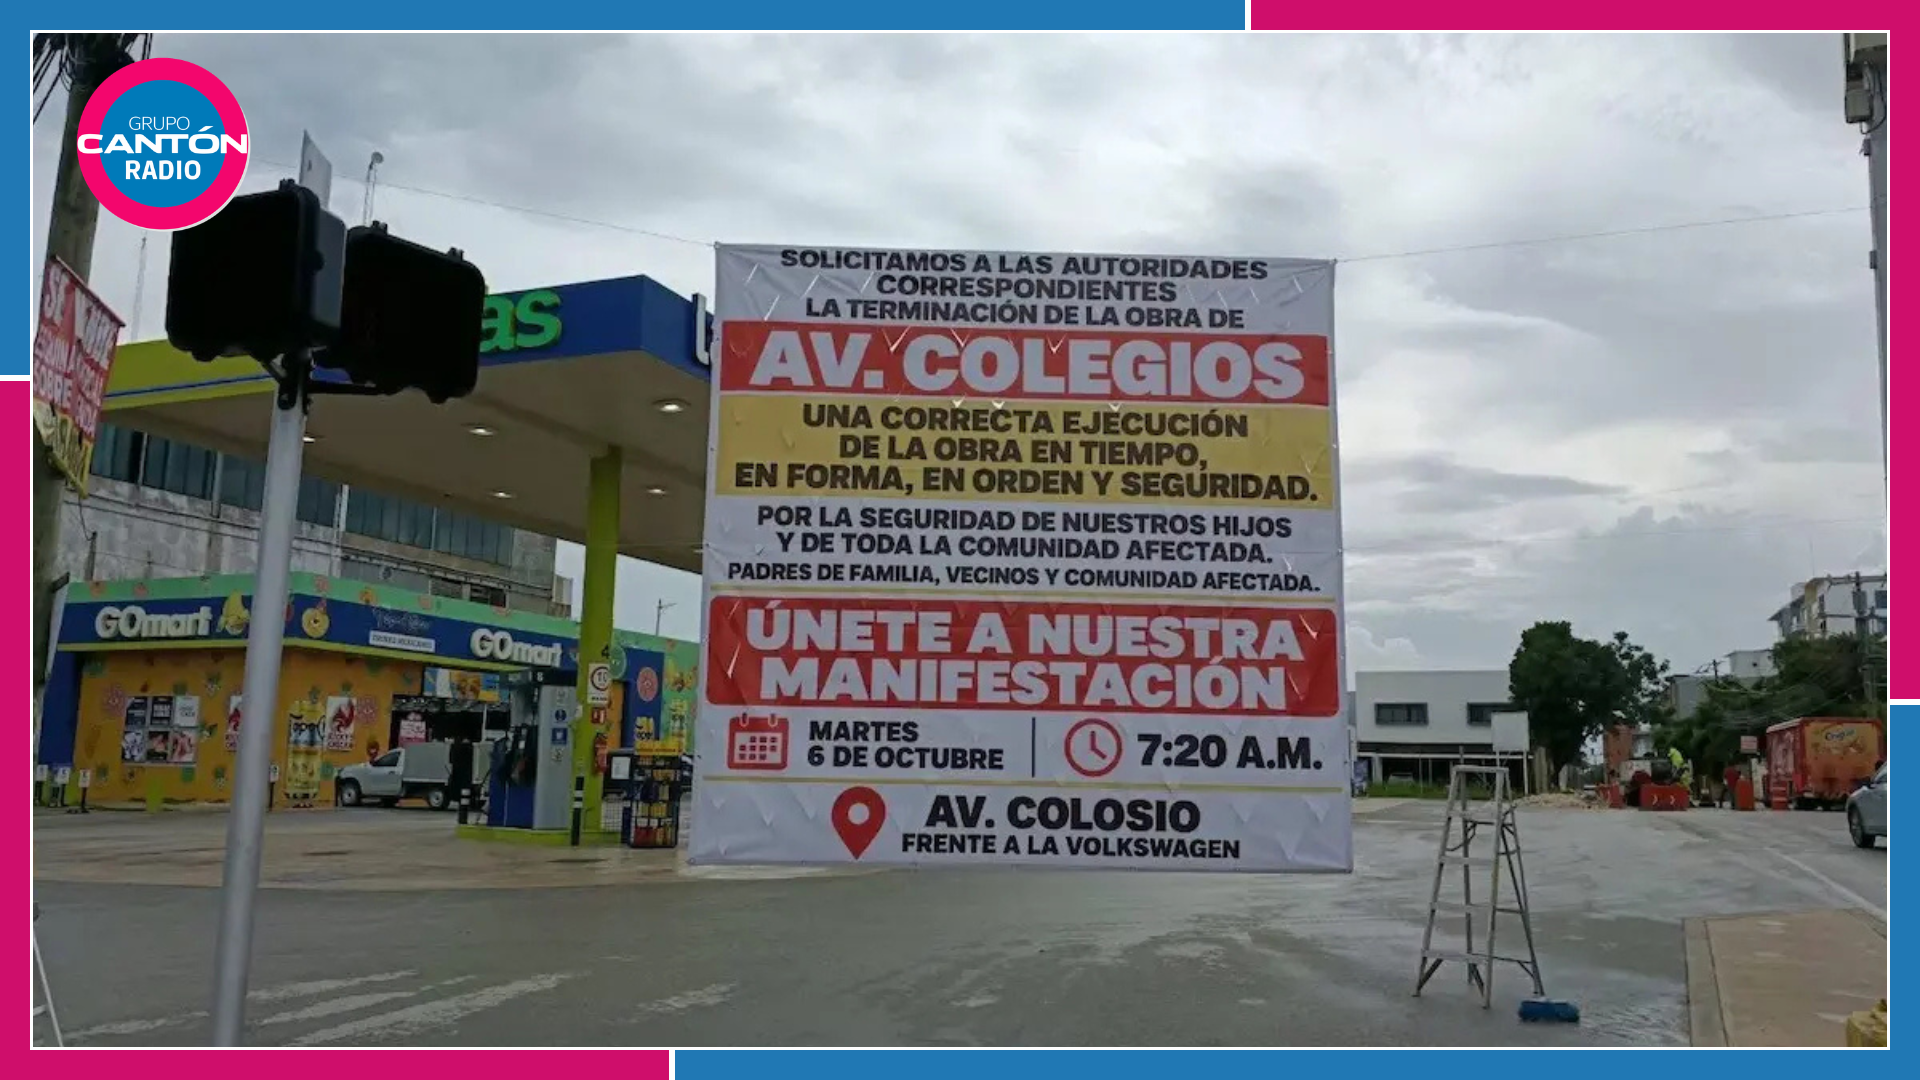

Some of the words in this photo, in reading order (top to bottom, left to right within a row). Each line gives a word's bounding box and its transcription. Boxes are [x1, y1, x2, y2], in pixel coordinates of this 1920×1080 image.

[781, 249, 966, 273] SOLICITAMOS
[972, 254, 991, 273] A
[1000, 255, 1053, 275] LAS
[1062, 256, 1268, 280] AUTORIDADES
[876, 274, 1177, 302] CORRESPONDIENTES
[806, 298, 841, 318] LA
[847, 298, 1037, 324] TERMINACIÓN
[1044, 305, 1079, 325] DE
[1086, 306, 1120, 326] LA
[1125, 307, 1201, 328] OBRA
[1208, 309, 1244, 329] DE
[749, 330, 884, 389] AV.
[903, 333, 1305, 400] COLEGIOS
[803, 403, 872, 429] UNA
[881, 406, 1054, 434] CORRECTA
[1063, 408, 1248, 438] EJECUCIÓN
[839, 434, 881, 459] DE
[888, 436, 927, 461] LA
[934, 437, 1023, 463] OBRA
[1031, 440, 1072, 465] EN
[1079, 441, 1207, 471] TIEMPO,
[735, 462, 778, 488] EN
[787, 463, 913, 495] FORMA,
[923, 467, 965, 492] EN
[972, 467, 1083, 495] ORDEN
[1090, 471, 1115, 497] Y
[1121, 471, 1318, 501] SEGURIDAD.
[757, 505, 812, 527] POR
[819, 507, 853, 528] LA
[860, 507, 1015, 531] SEGURIDAD
[1022, 511, 1055, 533] DE
[1062, 512, 1206, 536] NUESTROS
[1213, 516, 1292, 539] HIJOS
[776, 532, 795, 553] Y
[801, 532, 834, 554] DE
[841, 533, 913, 556] TODA
[919, 535, 952, 556] LA
[958, 536, 1119, 560] COMUNIDAD
[1126, 540, 1273, 564] AFECTADA.
[728, 563, 812, 582] PADRES
[817, 564, 844, 582] DE
[849, 564, 940, 586] FAMILIA,
[946, 566, 1040, 586] VECINOS
[1045, 568, 1060, 586] Y
[1065, 568, 1198, 590] COMUNIDAD
[1202, 572, 1320, 592] AFECTADA.
[95, 605, 213, 639] GOmart
[747, 600, 952, 653] ÚNETE
[966, 612, 1013, 654] A
[1028, 613, 1304, 661] NUESTRA
[470, 628, 563, 668] GOmart
[760, 656, 1287, 710] MANIFESTACIÓN
[809, 720, 919, 743] MARTES
[807, 745, 825, 767] 6
[833, 746, 868, 768] DE
[875, 747, 1004, 770] OCTUBRE
[1137, 734, 1227, 768] 7:20
[1237, 736, 1323, 770] A.M.
[925, 794, 995, 829] AV.
[1006, 796, 1201, 833] COLOSIO
[902, 833, 996, 854] FRENTE
[1002, 835, 1020, 855] A
[1028, 836, 1059, 856] LA
[1065, 837, 1240, 859] VOLKSWAGEN
